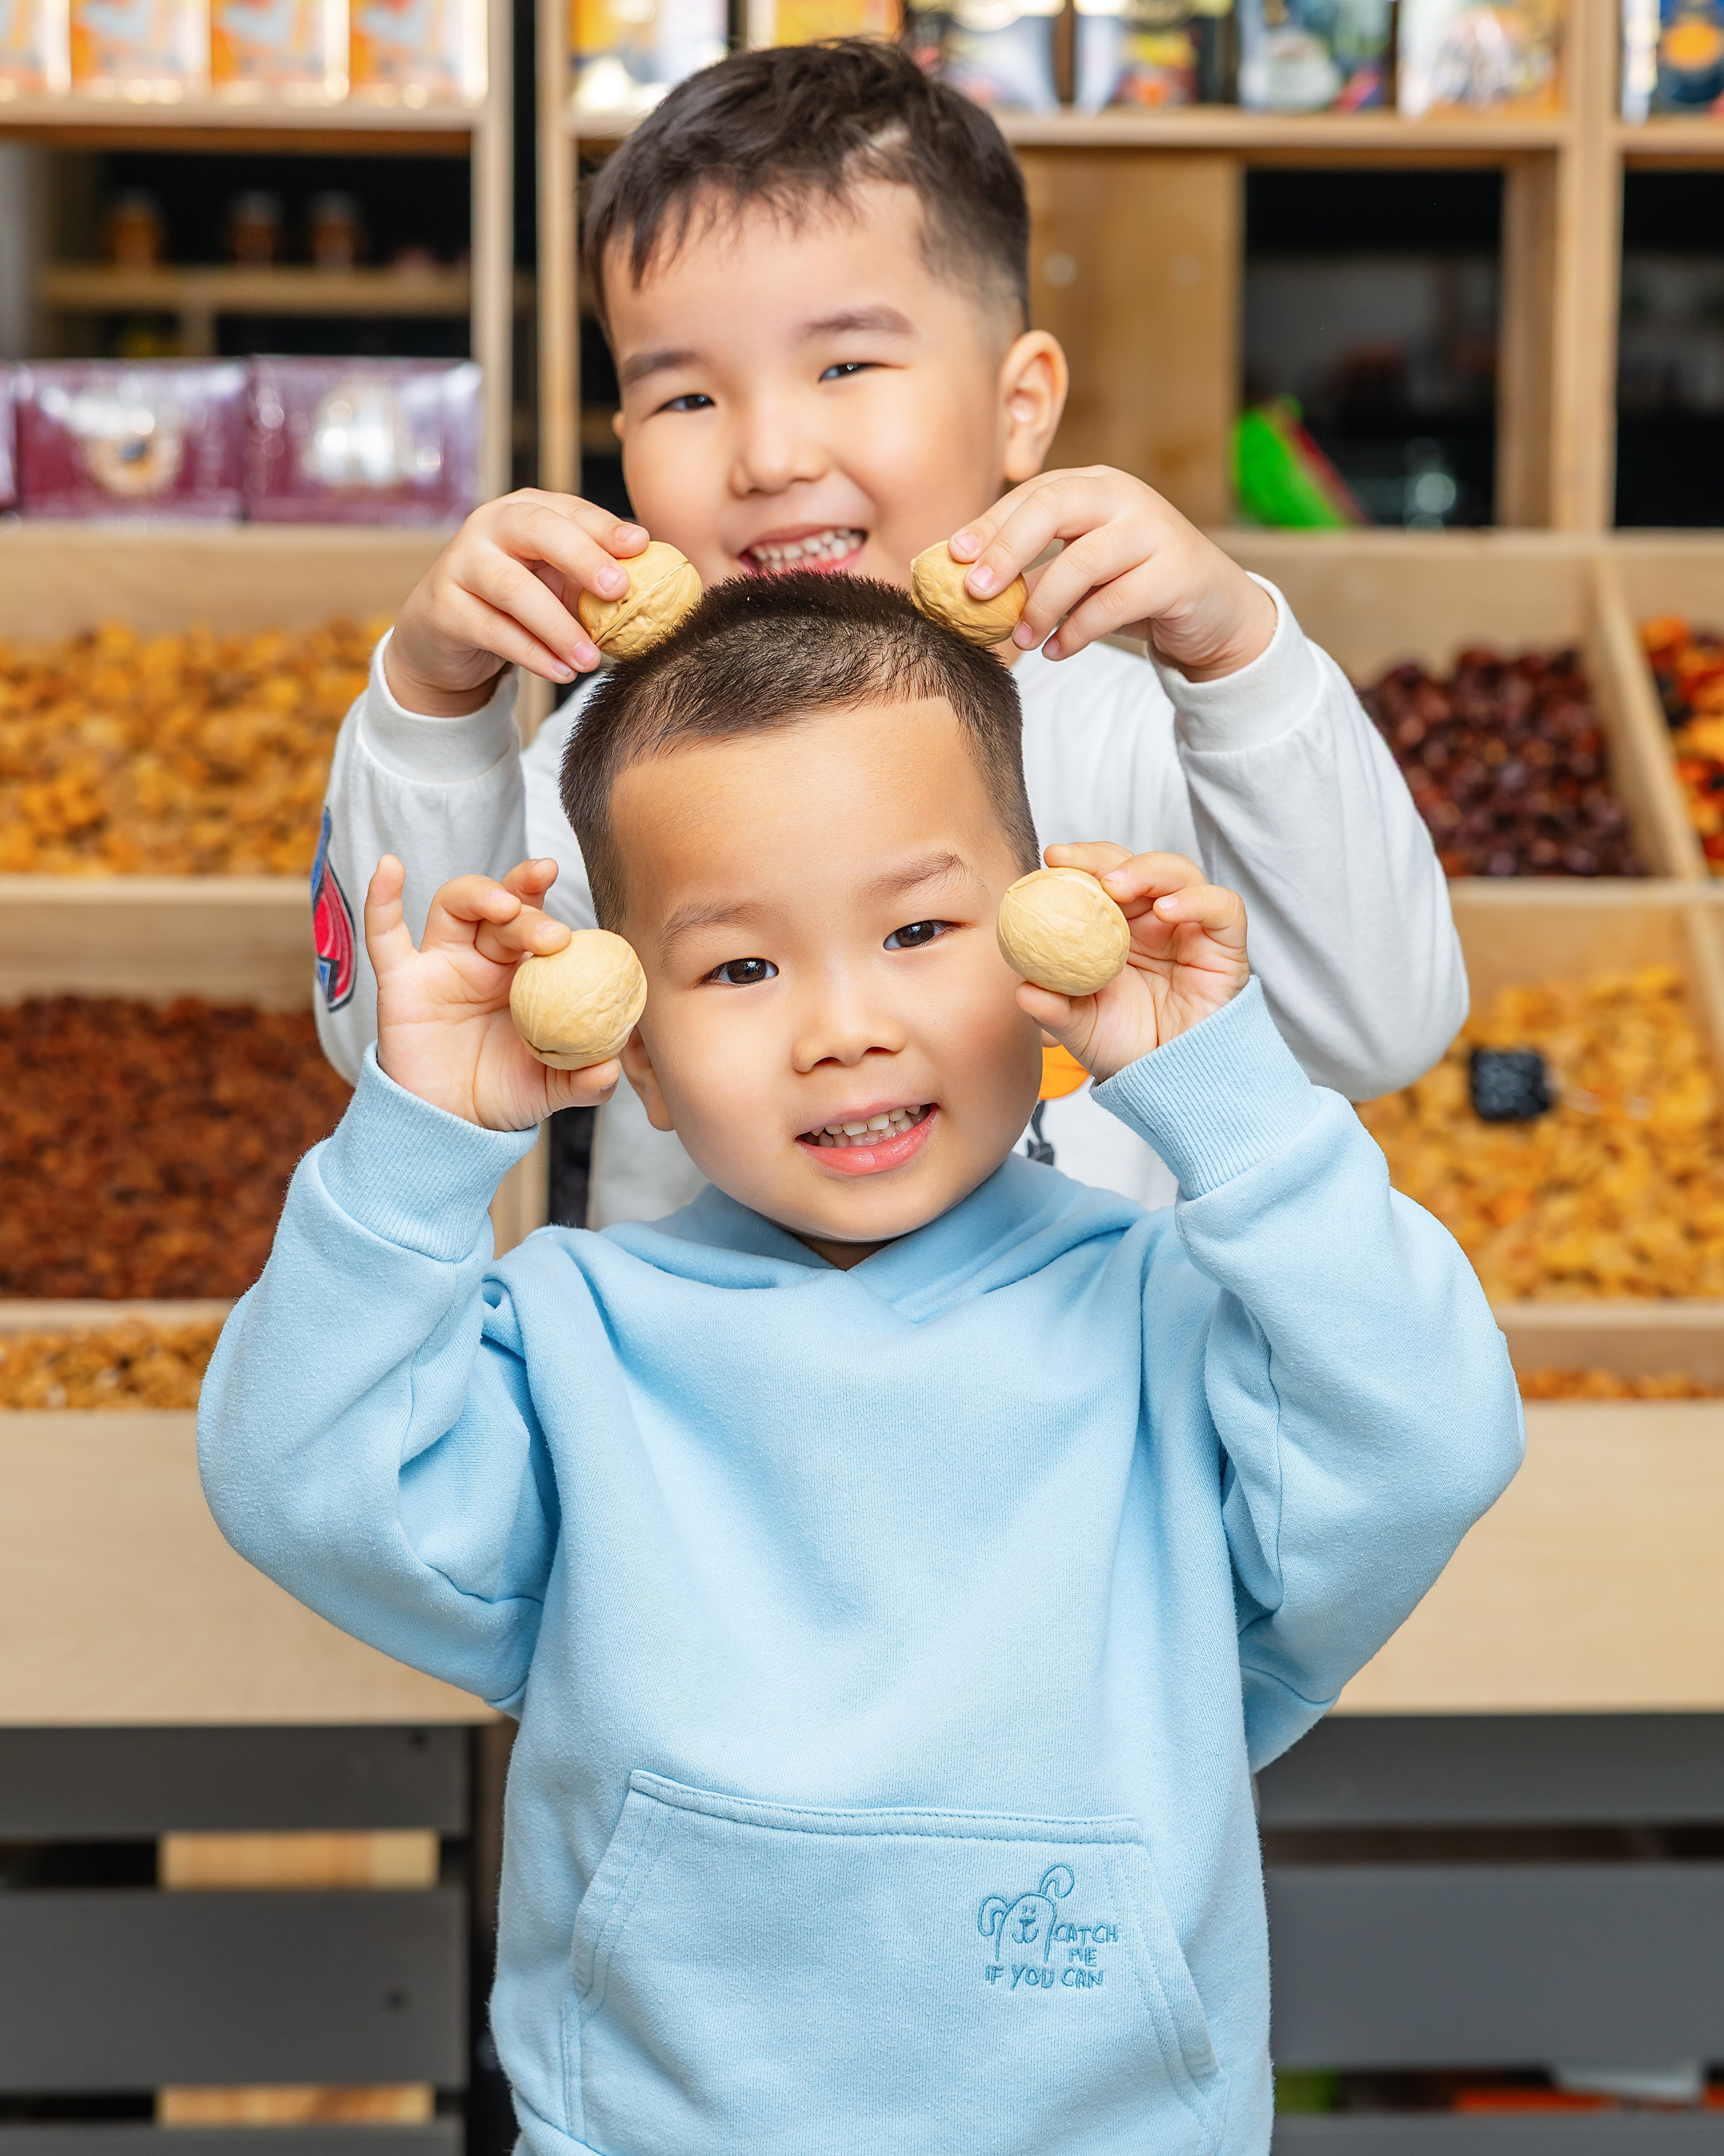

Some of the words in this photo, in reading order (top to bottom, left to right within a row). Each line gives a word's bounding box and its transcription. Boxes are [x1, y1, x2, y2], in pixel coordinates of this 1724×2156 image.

[1053, 1923, 1119, 1947] CATCH
[1068, 1947, 1098, 1967] ME
[985, 1965, 1004, 1985] IF
[1012, 1964, 1055, 1991] YOU
[1061, 1967, 1104, 1989] CAN
